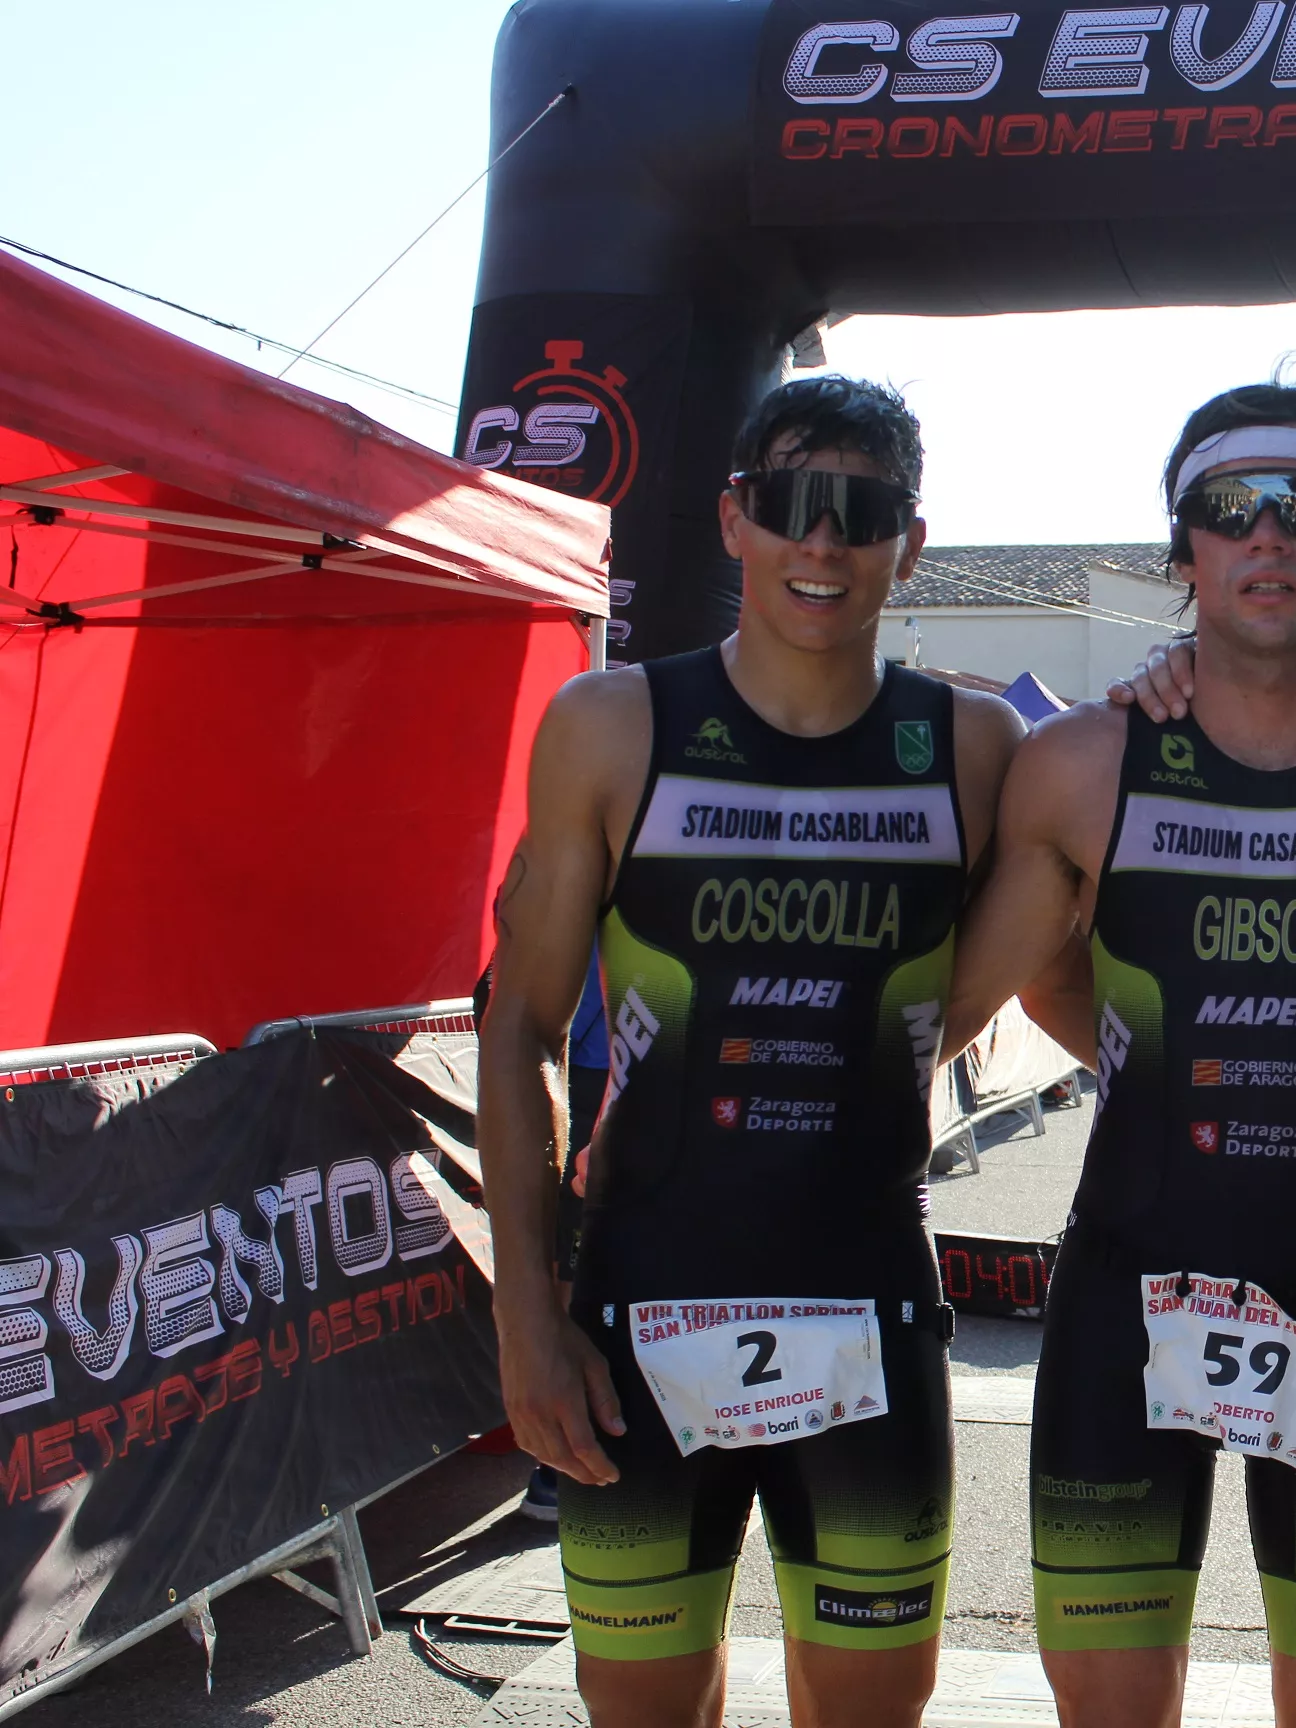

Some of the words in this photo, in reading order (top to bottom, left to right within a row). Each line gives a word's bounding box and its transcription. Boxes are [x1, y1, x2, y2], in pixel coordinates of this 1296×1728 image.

[783, 13, 1019, 104] CS
[463, 402, 599, 468] CS
[681, 804, 782, 841] STADIUM
[788, 811, 930, 844] CASABLANCA
[1152, 821, 1242, 860] STADIUM
[691, 878, 899, 949] COSCOLLA
[728, 976, 845, 1009] MAPEI
[750, 1052, 770, 1064] DE
[751, 1039, 834, 1054] GOBIERNO
[1222, 1073, 1244, 1086] DE
[749, 1097, 836, 1116] Zaragoza
[746, 1114, 834, 1132] DEPORTE
[308, 1265, 466, 1363] GESTION
[679, 1304, 784, 1322] TRIATLON
[1187, 1296, 1241, 1322] JUAN
[1243, 1307, 1280, 1327] DEL
[638, 1320, 681, 1344] SAN
[736, 1330, 782, 1387] 2
[1203, 1331, 1291, 1395] 59
[755, 1388, 825, 1413] ENRIQUE
[767, 1416, 799, 1434] barri
[1228, 1428, 1261, 1447] barri
[1062, 1598, 1171, 1617] HAMMELMANN
